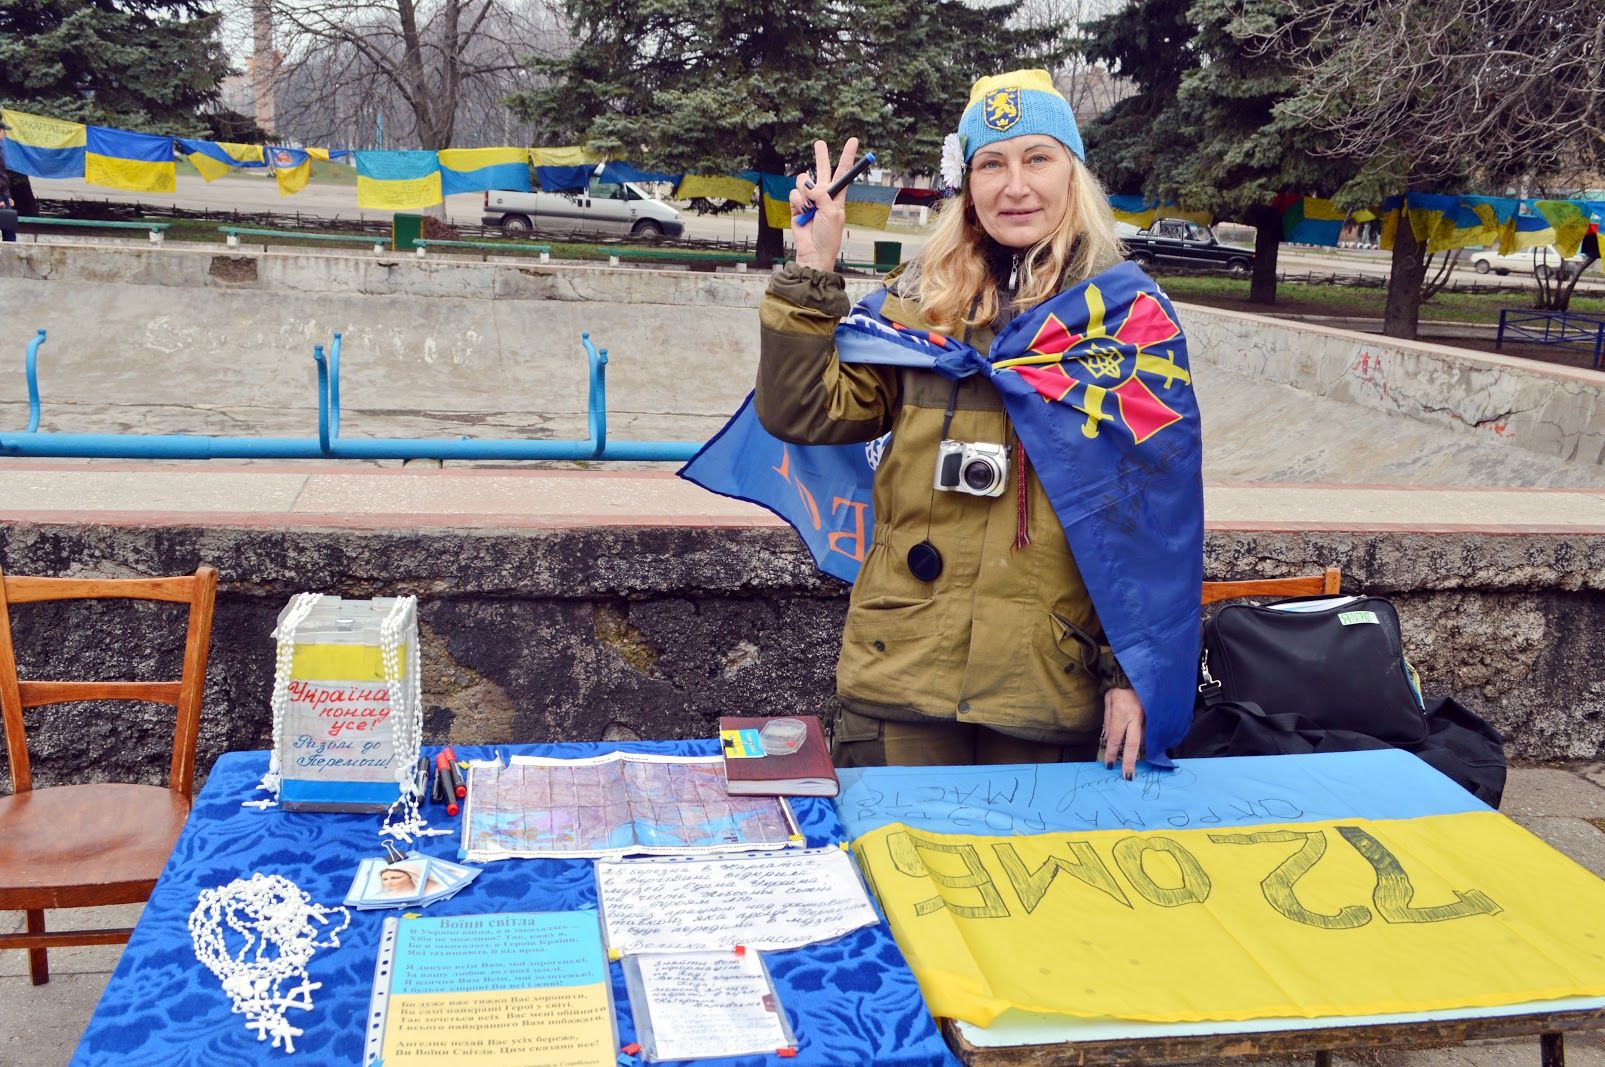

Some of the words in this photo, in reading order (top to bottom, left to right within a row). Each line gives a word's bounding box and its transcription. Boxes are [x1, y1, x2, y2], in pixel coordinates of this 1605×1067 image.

[287, 681, 391, 710] Україна
[361, 741, 382, 754] до
[888, 830, 1212, 919] ОМБ
[1208, 825, 1504, 930] 72
[440, 918, 483, 929] Воїни
[488, 917, 535, 928] світла
[506, 1012, 526, 1020] Вас
[522, 1019, 544, 1027] Вам
[486, 1037, 508, 1046] Вас
